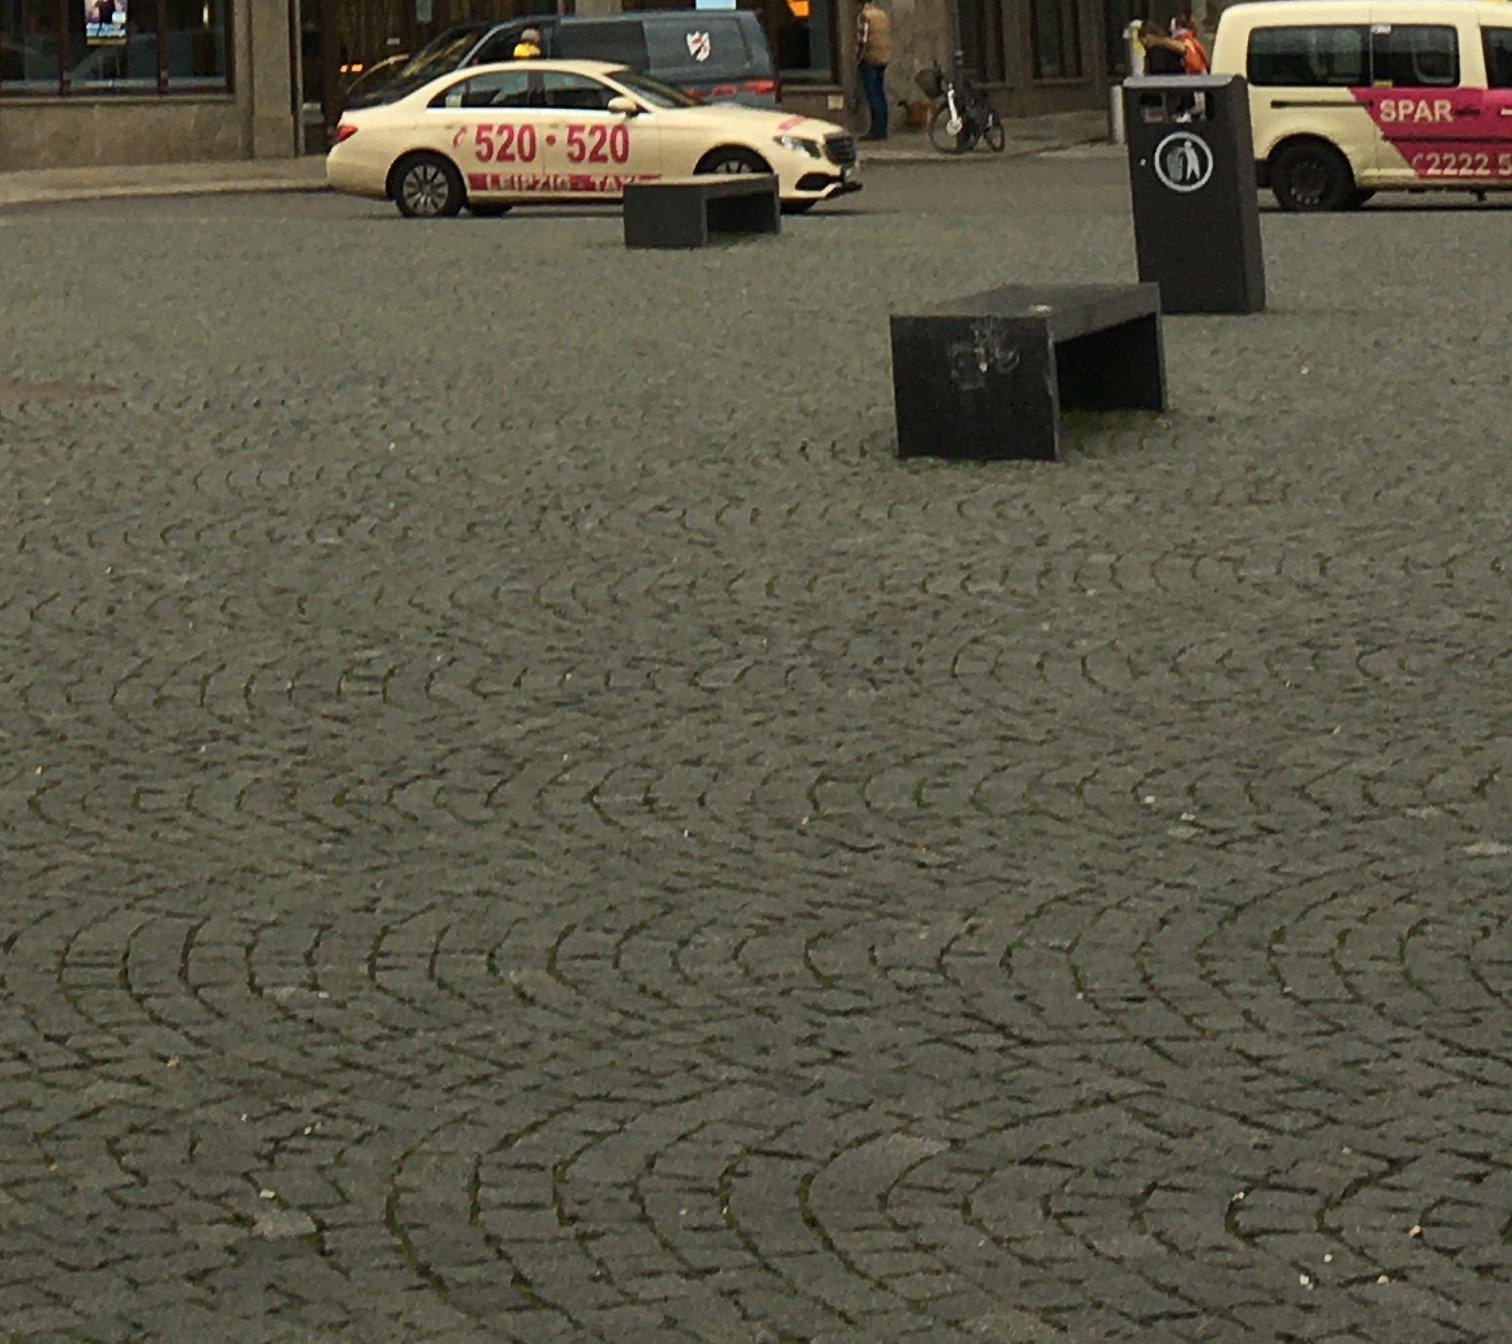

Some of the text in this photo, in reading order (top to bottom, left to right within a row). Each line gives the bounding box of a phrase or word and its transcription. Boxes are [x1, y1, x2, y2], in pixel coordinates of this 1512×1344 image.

[1379, 99, 1454, 124] SPAR
[475, 123, 630, 164] 520 520
[1425, 152, 1491, 177] 2222
